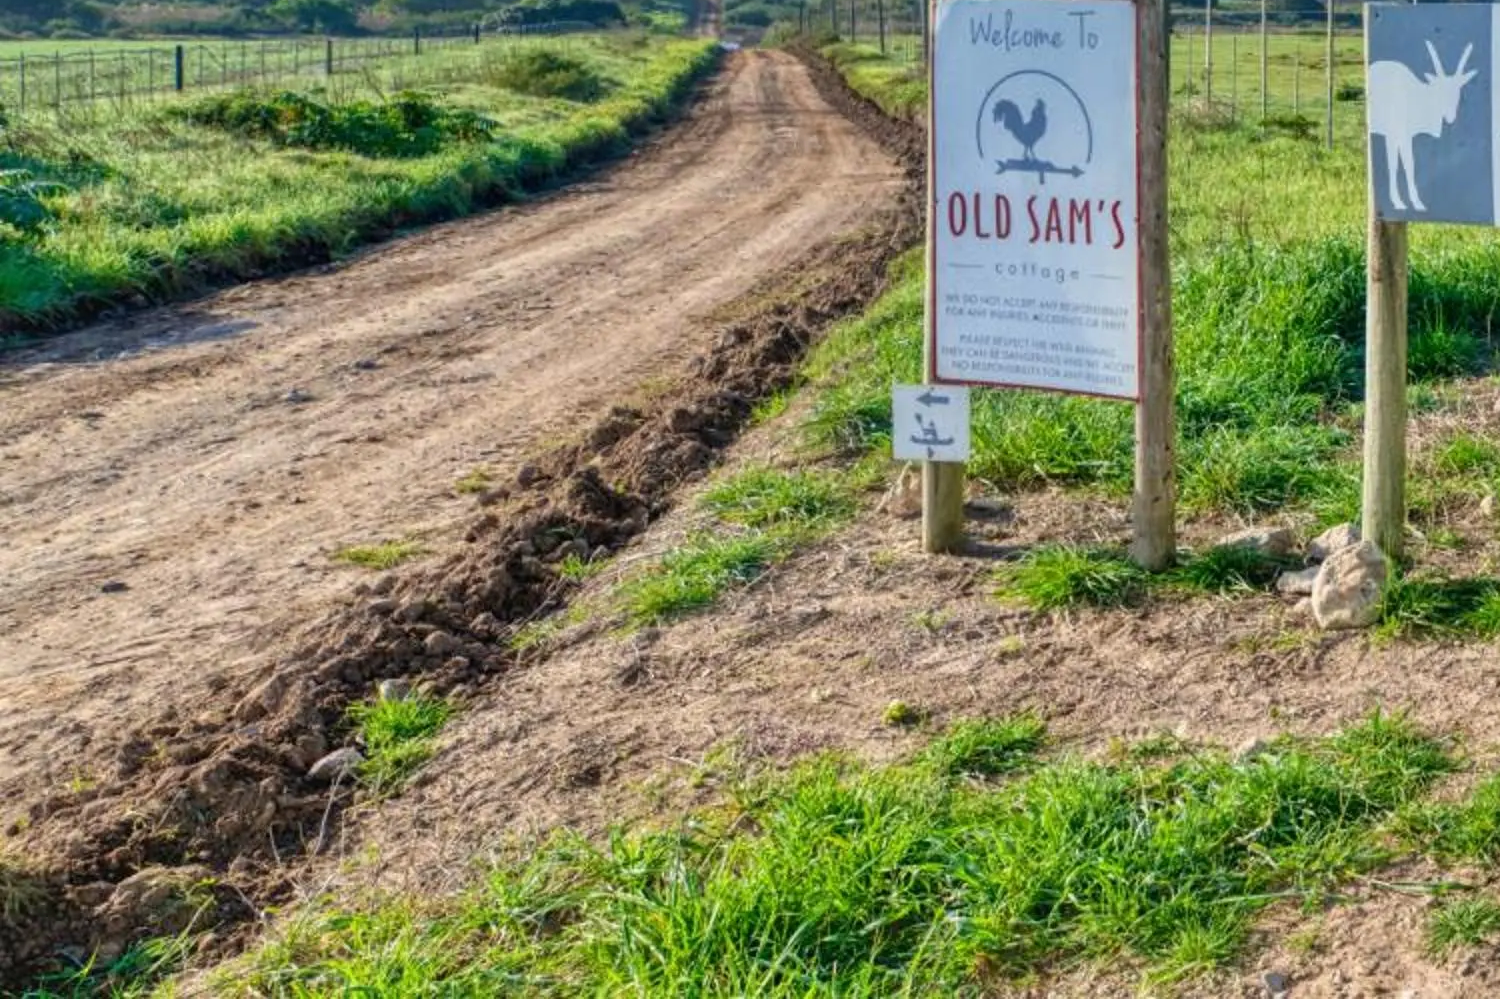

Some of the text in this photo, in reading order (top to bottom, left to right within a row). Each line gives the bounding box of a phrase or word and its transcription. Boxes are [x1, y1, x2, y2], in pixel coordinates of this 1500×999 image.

[970, 9, 1099, 51] Welcome To
[947, 191, 1125, 250] OLD SAM'S
[994, 262, 1081, 284] cottage
